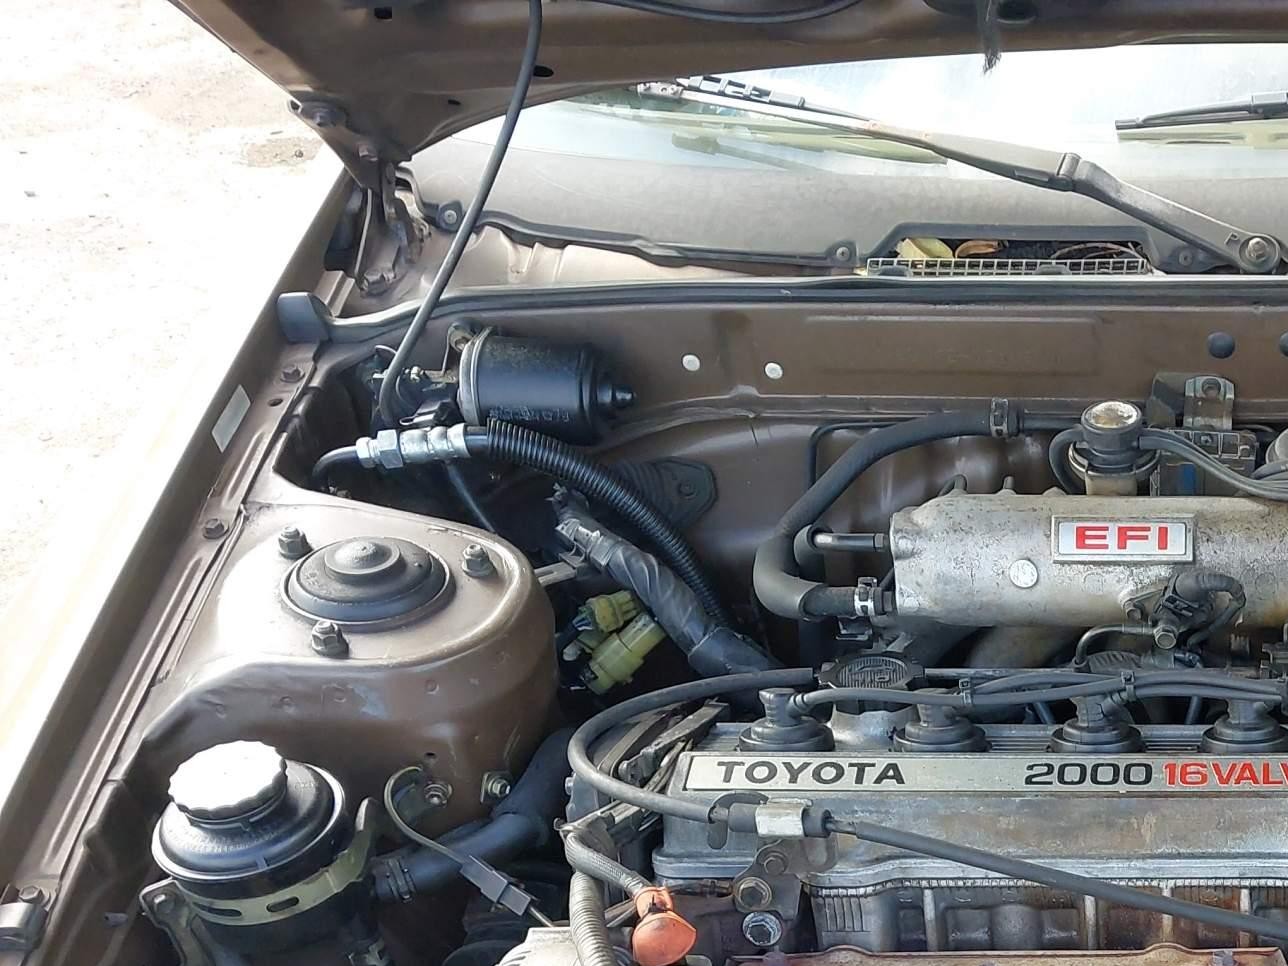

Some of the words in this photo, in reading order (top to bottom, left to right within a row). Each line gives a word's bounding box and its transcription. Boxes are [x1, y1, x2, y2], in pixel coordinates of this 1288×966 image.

[1075, 526, 1168, 550] EFI
[717, 761, 905, 785] TOYOTA
[1024, 762, 1152, 786] 2000
